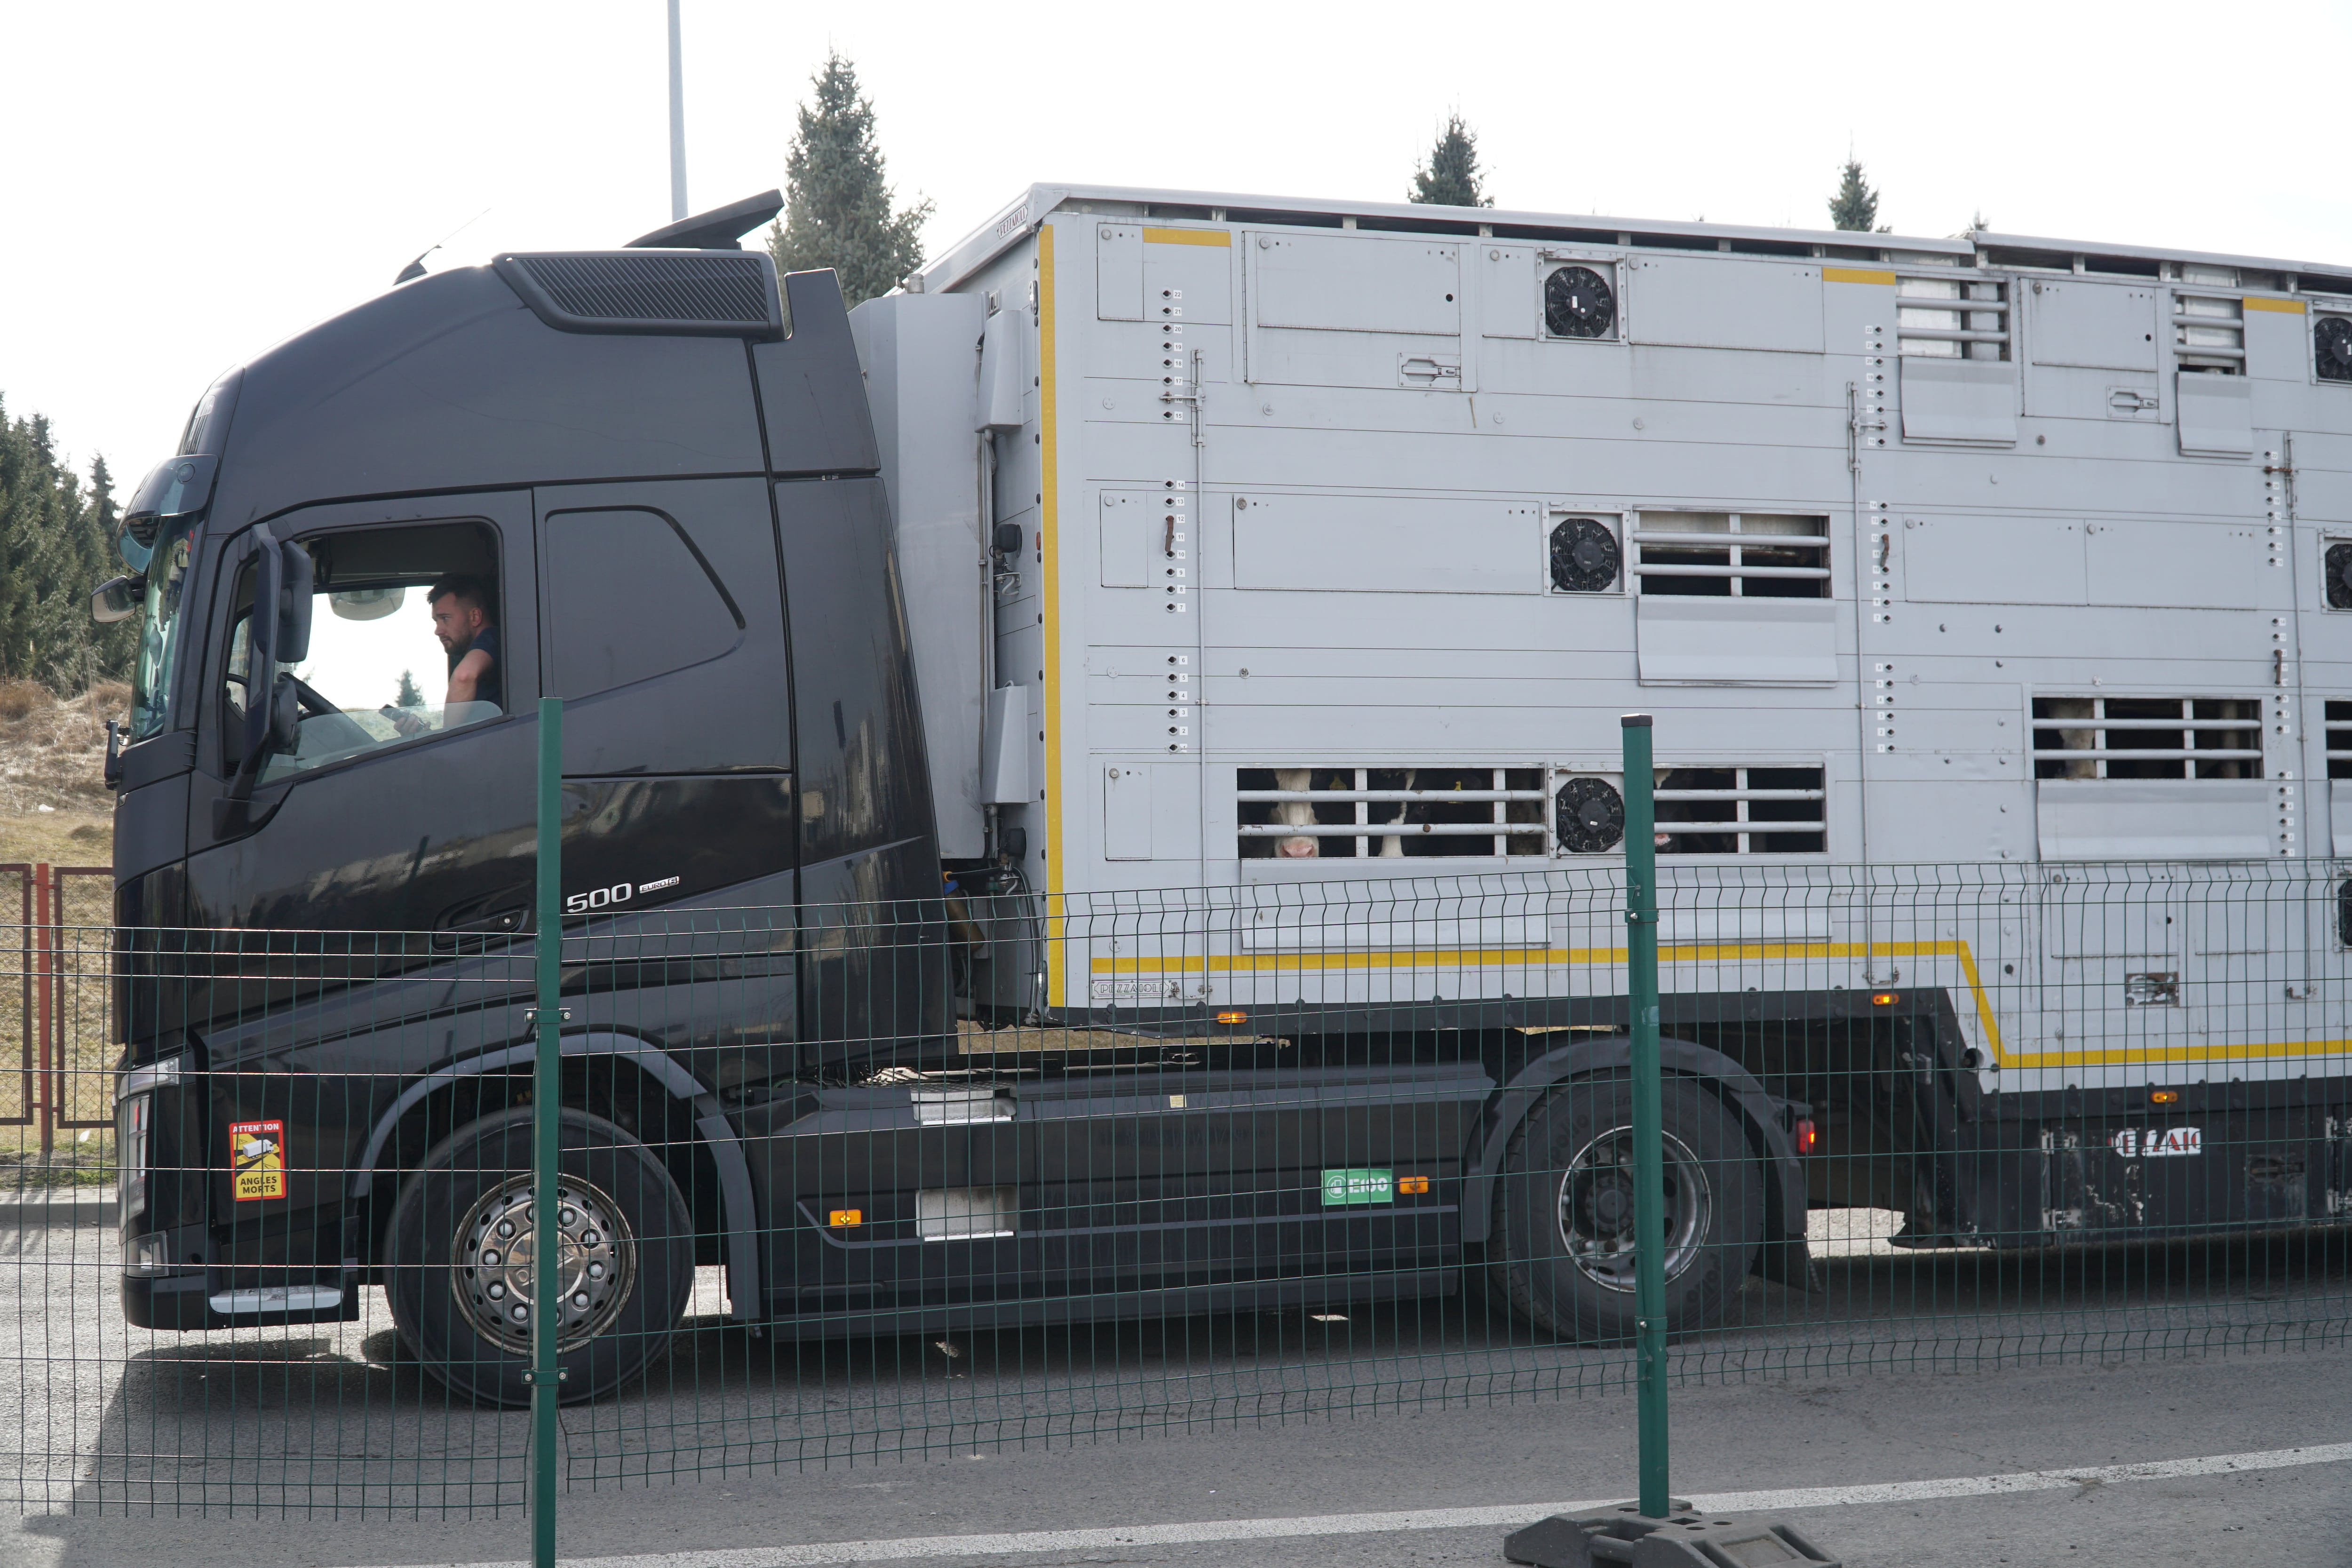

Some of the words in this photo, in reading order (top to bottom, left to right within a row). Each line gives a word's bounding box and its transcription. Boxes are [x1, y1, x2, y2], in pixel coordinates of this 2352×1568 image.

[1000, 207, 1025, 236] PEZZAIOLI
[642, 881, 667, 891] EURO
[567, 883, 632, 913] 500
[232, 1123, 279, 1133] ATTENTION
[240, 1176, 277, 1186] ANGLES
[1349, 1178, 1388, 1194] E100
[243, 1185, 276, 1194] MORTS
